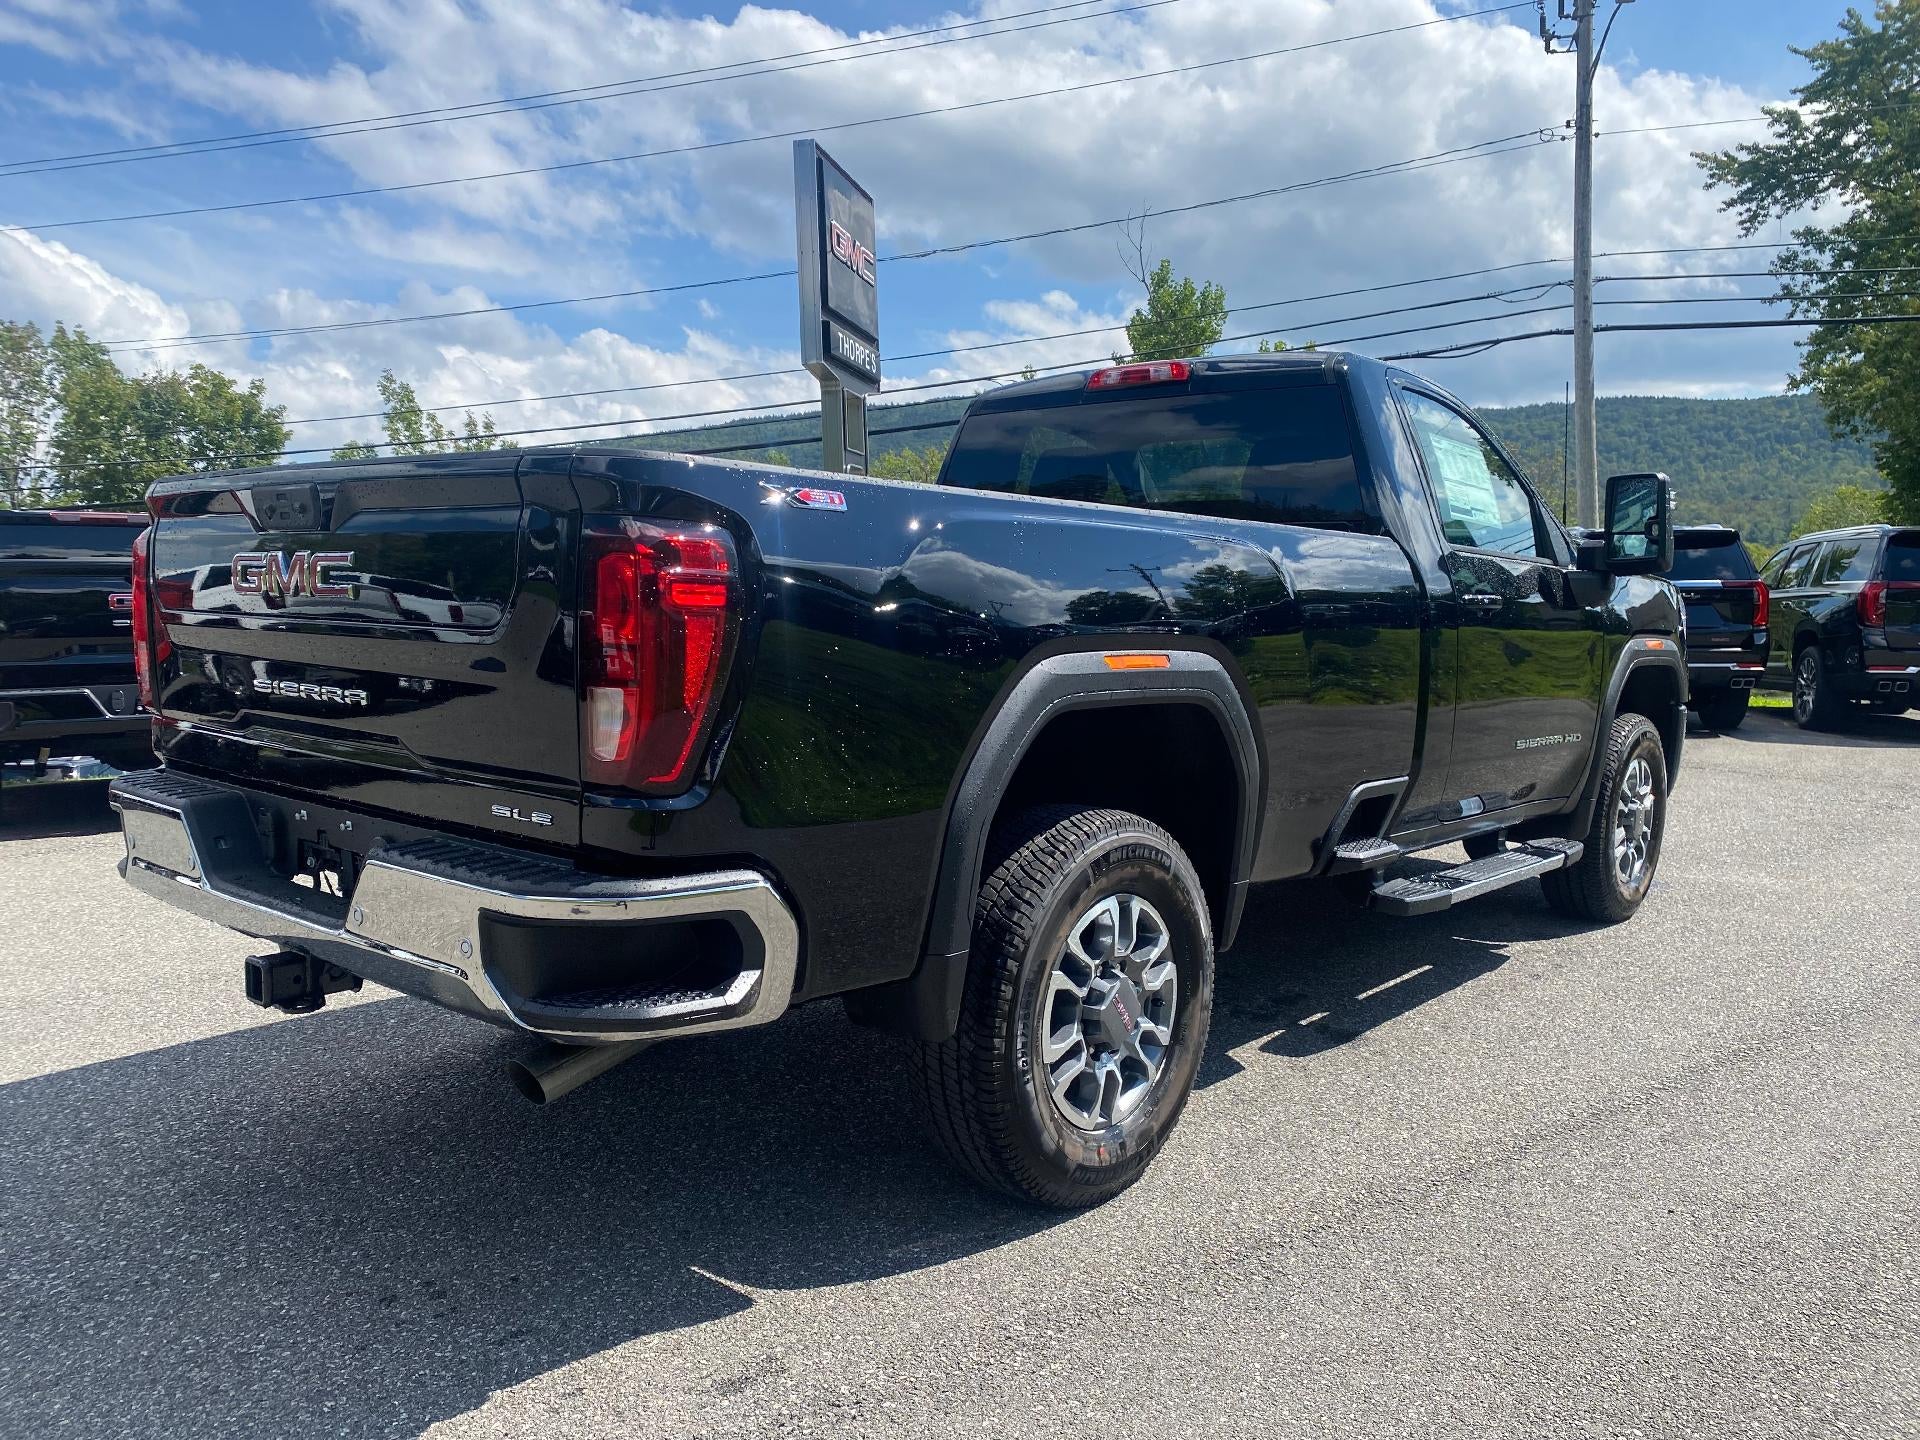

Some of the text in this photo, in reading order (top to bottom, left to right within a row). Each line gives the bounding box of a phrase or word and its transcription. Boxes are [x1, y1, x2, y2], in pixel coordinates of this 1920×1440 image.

[830, 220, 875, 287] GMC
[839, 332, 876, 373] THORPE'S
[231, 549, 356, 600] GMC
[253, 678, 370, 707] SIERRA
[1516, 733, 1581, 749] SIERRA HD
[491, 805, 553, 825] SLE
[1109, 844, 1172, 868] MICHELIN
